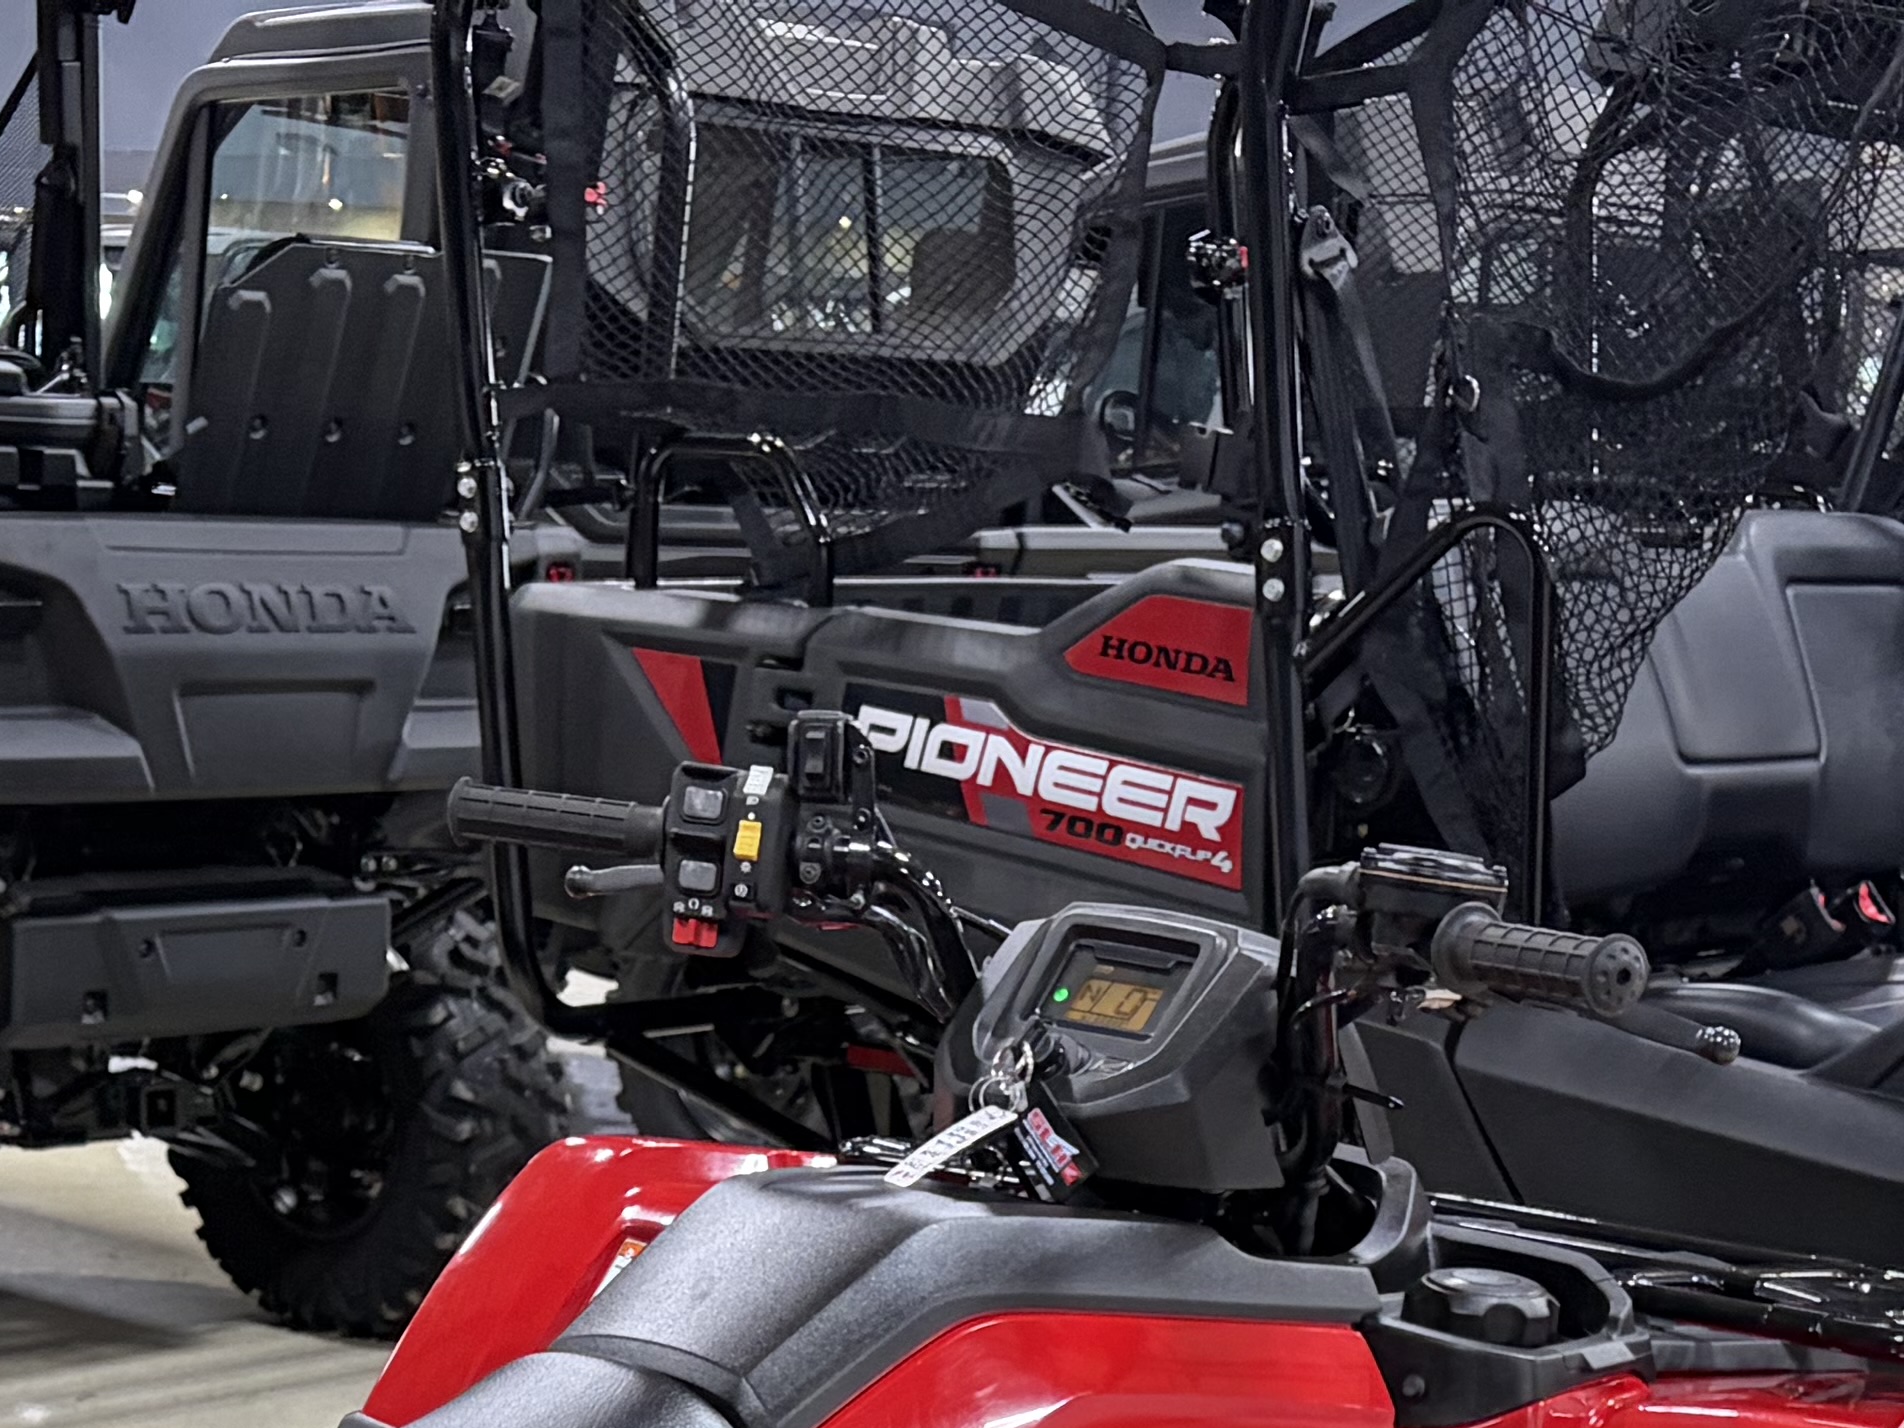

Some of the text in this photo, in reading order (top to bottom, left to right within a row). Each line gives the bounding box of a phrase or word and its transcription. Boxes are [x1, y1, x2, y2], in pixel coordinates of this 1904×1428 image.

[115, 582, 417, 635] HONDA
[1099, 634, 1236, 683] HONDA
[857, 704, 1238, 842] PIONEER
[1039, 807, 1125, 848] 700
